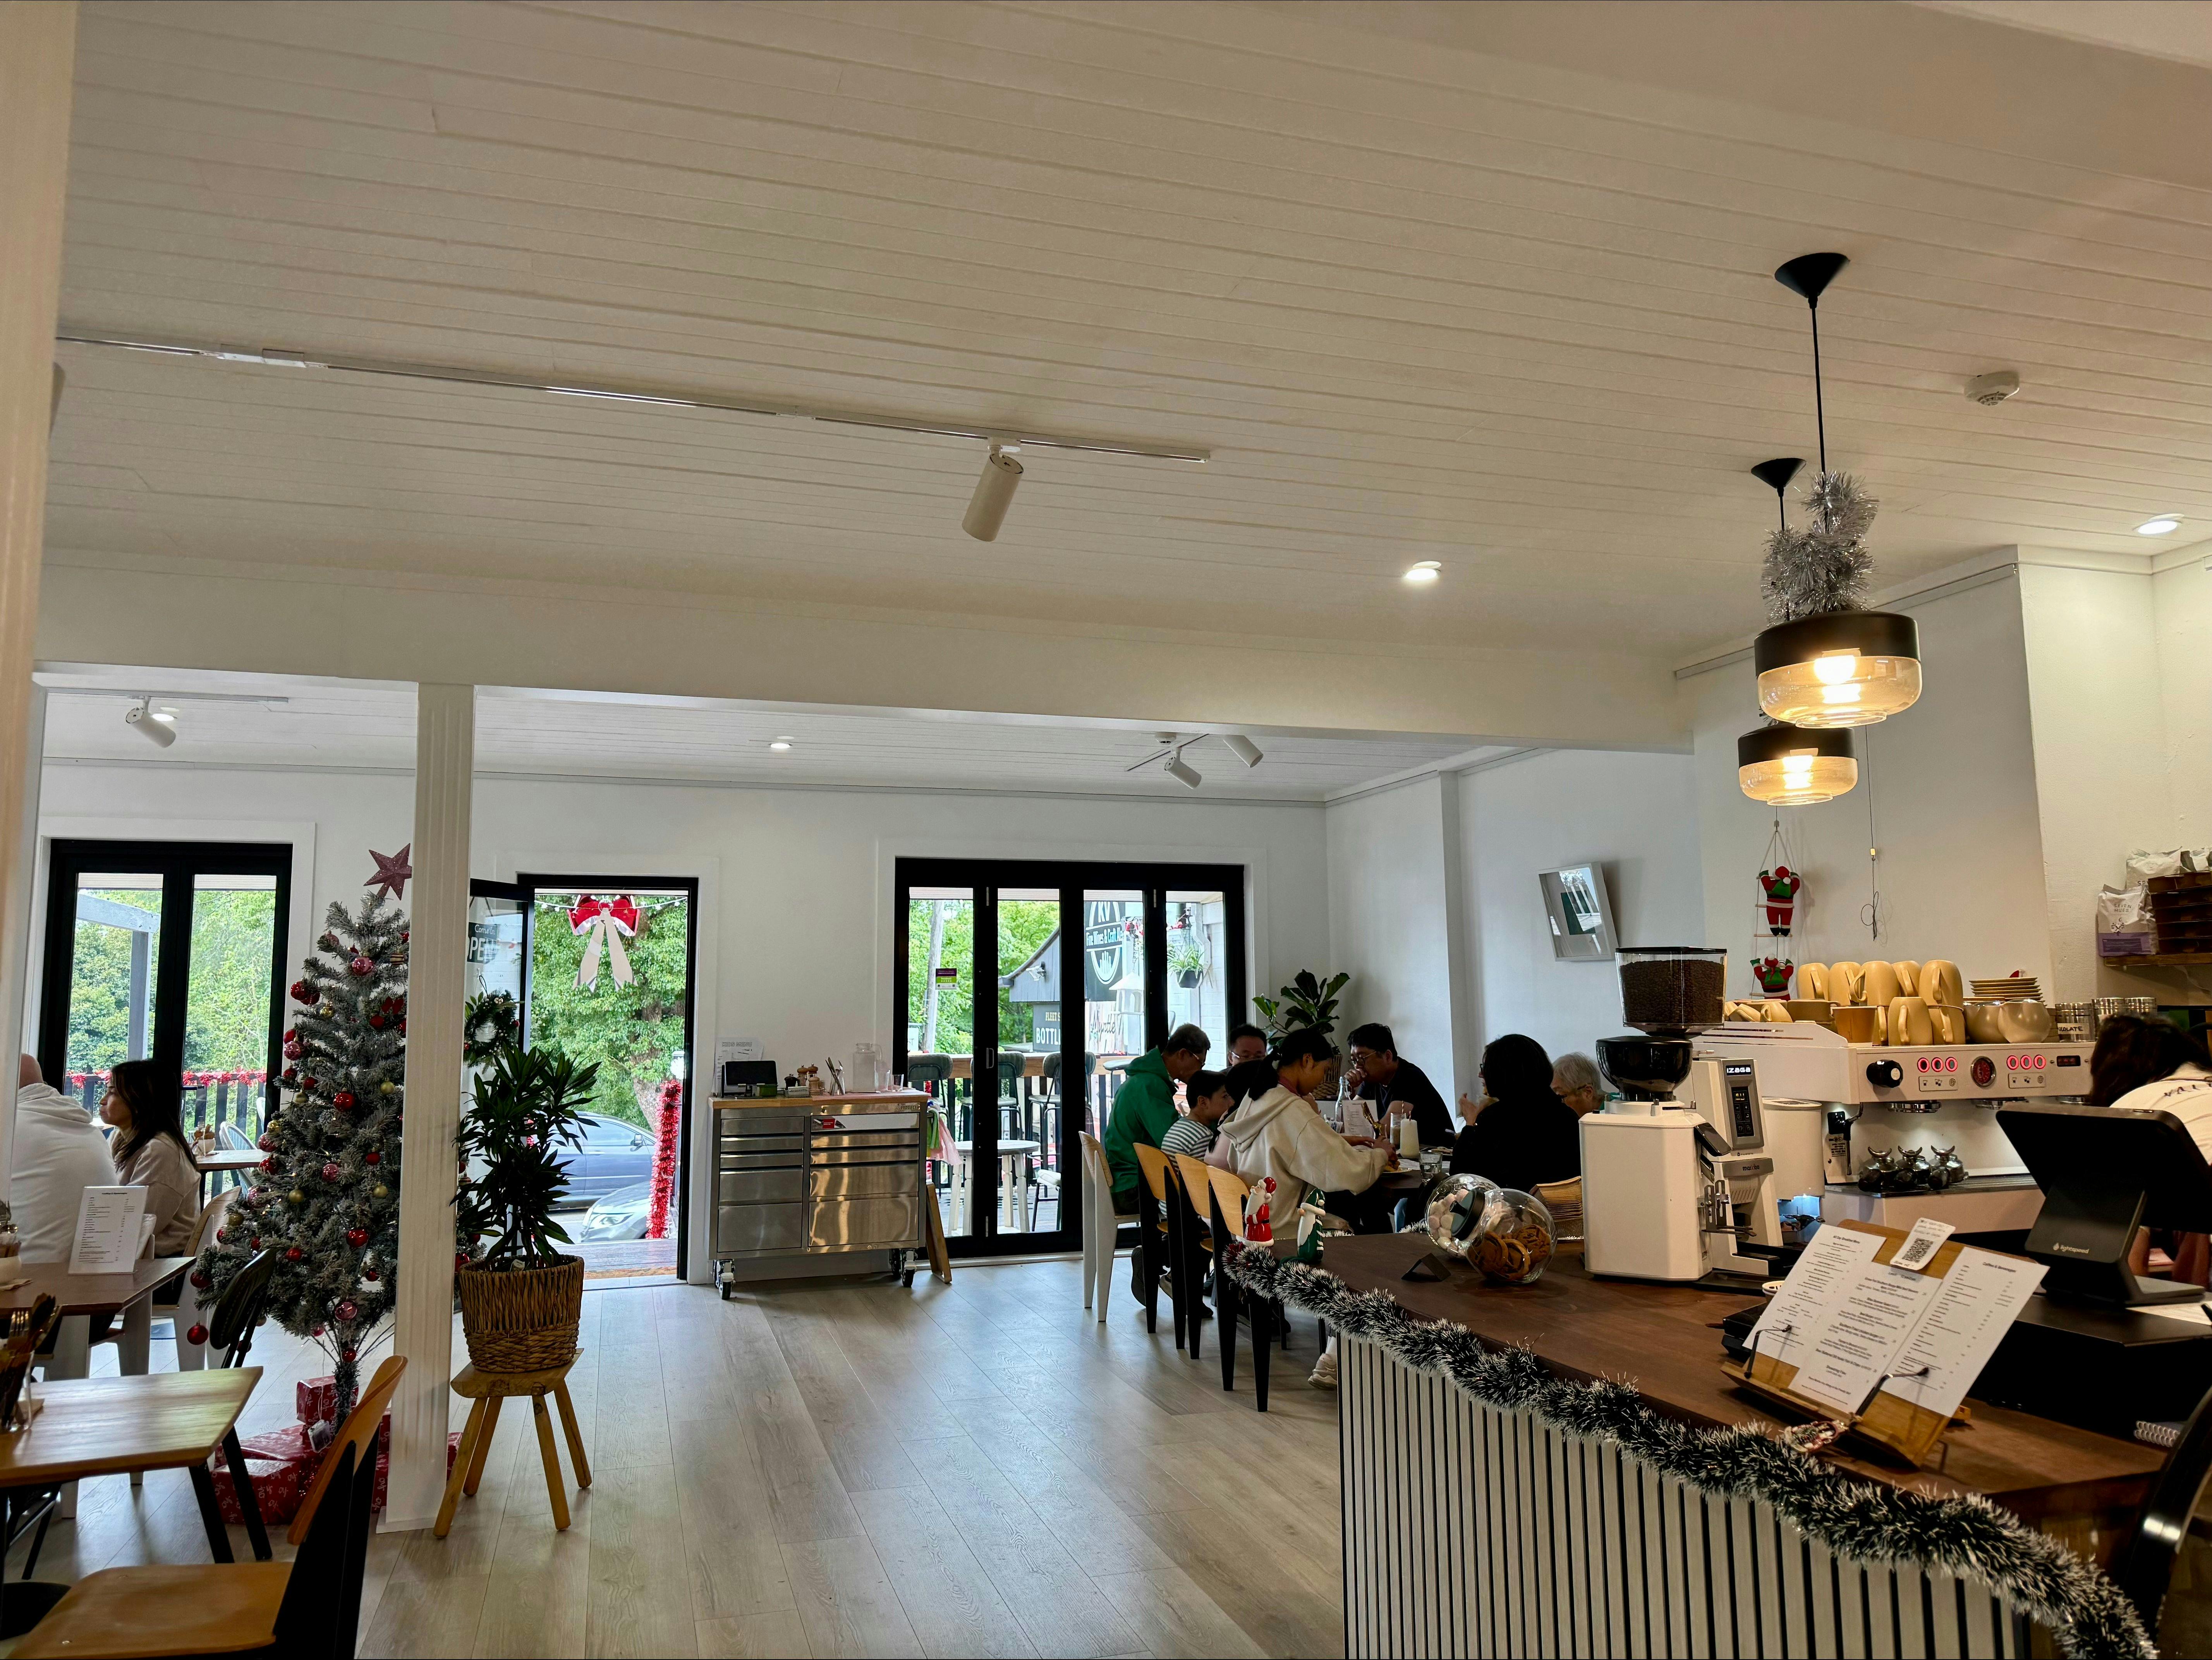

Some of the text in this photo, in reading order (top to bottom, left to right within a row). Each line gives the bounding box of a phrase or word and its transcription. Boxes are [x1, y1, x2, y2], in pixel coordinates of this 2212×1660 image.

[475, 924, 489, 934] Come
[1046, 1012, 1057, 1021] FLEET
[2061, 1245, 2089, 1254] lightspeed
